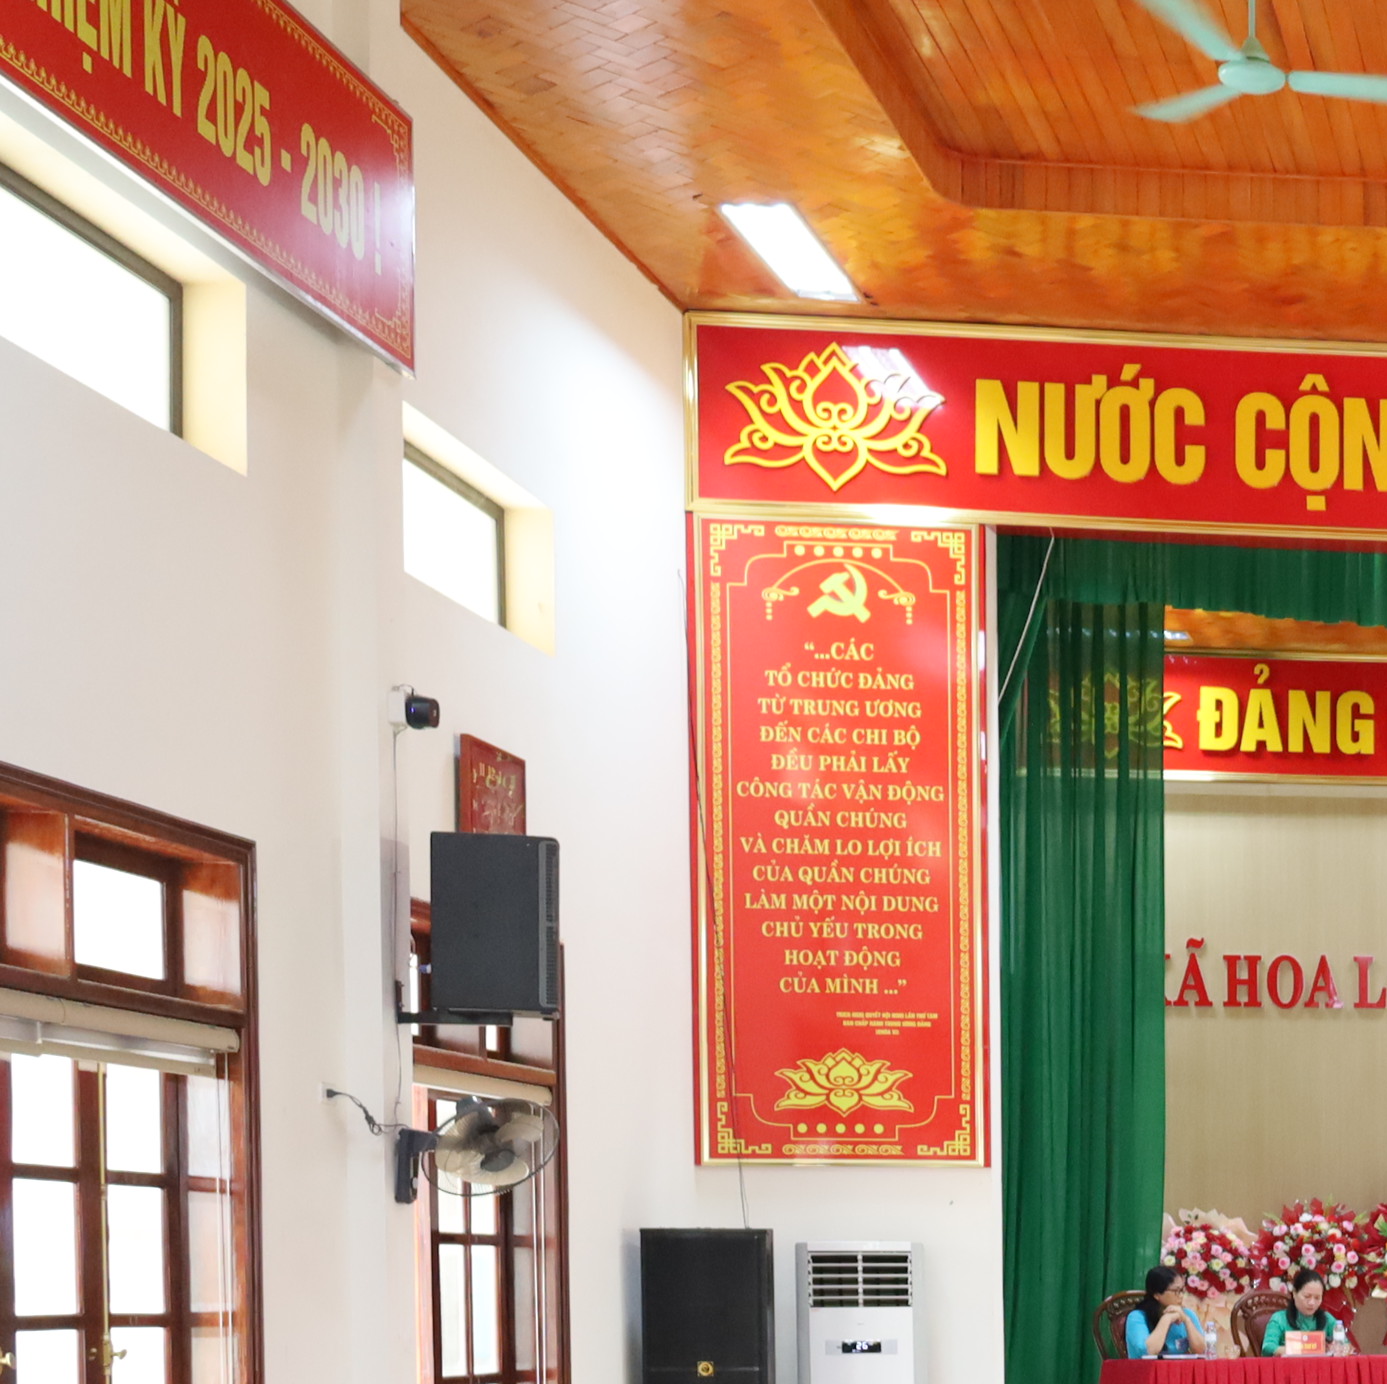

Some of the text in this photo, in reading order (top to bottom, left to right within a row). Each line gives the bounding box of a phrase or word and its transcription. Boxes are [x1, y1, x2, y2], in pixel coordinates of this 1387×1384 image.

[197, 35, 271, 186] 2025
[281, 149, 292, 173] -
[301, 123, 364, 260] 2030
[975, 364, 1205, 484] NƯỚC
[764, 664, 913, 689] TỔ CHỨC ĐẢNG
[758, 693, 921, 717] TỪ TRUNG ƯƠNG
[1197, 664, 1375, 754] ĐẢNG
[760, 720, 920, 749] ĐẾN CÁC CHI BỘ
[771, 749, 909, 772] ĐỀU PHẢI LẤY
[737, 776, 944, 805] CÔNG TÁC VẬN ĐỘNG
[774, 804, 906, 829] QUẦN CHÚNG
[740, 833, 941, 859] VÀ CHĂM LO LỢI ÍCH
[753, 860, 930, 885] CỦA QUẦN CHÚNG
[745, 889, 938, 914] LÀM MỘT NỘI DUNG
[762, 916, 922, 939] CHỦ YẾU TRONG
[785, 946, 900, 970] HOẠT ĐỘNG
[780, 972, 820, 992] CỦA
[826, 974, 877, 993] MÌNH
[1165, 938, 1213, 1007] Ã
[1223, 955, 1344, 1009] HOA
